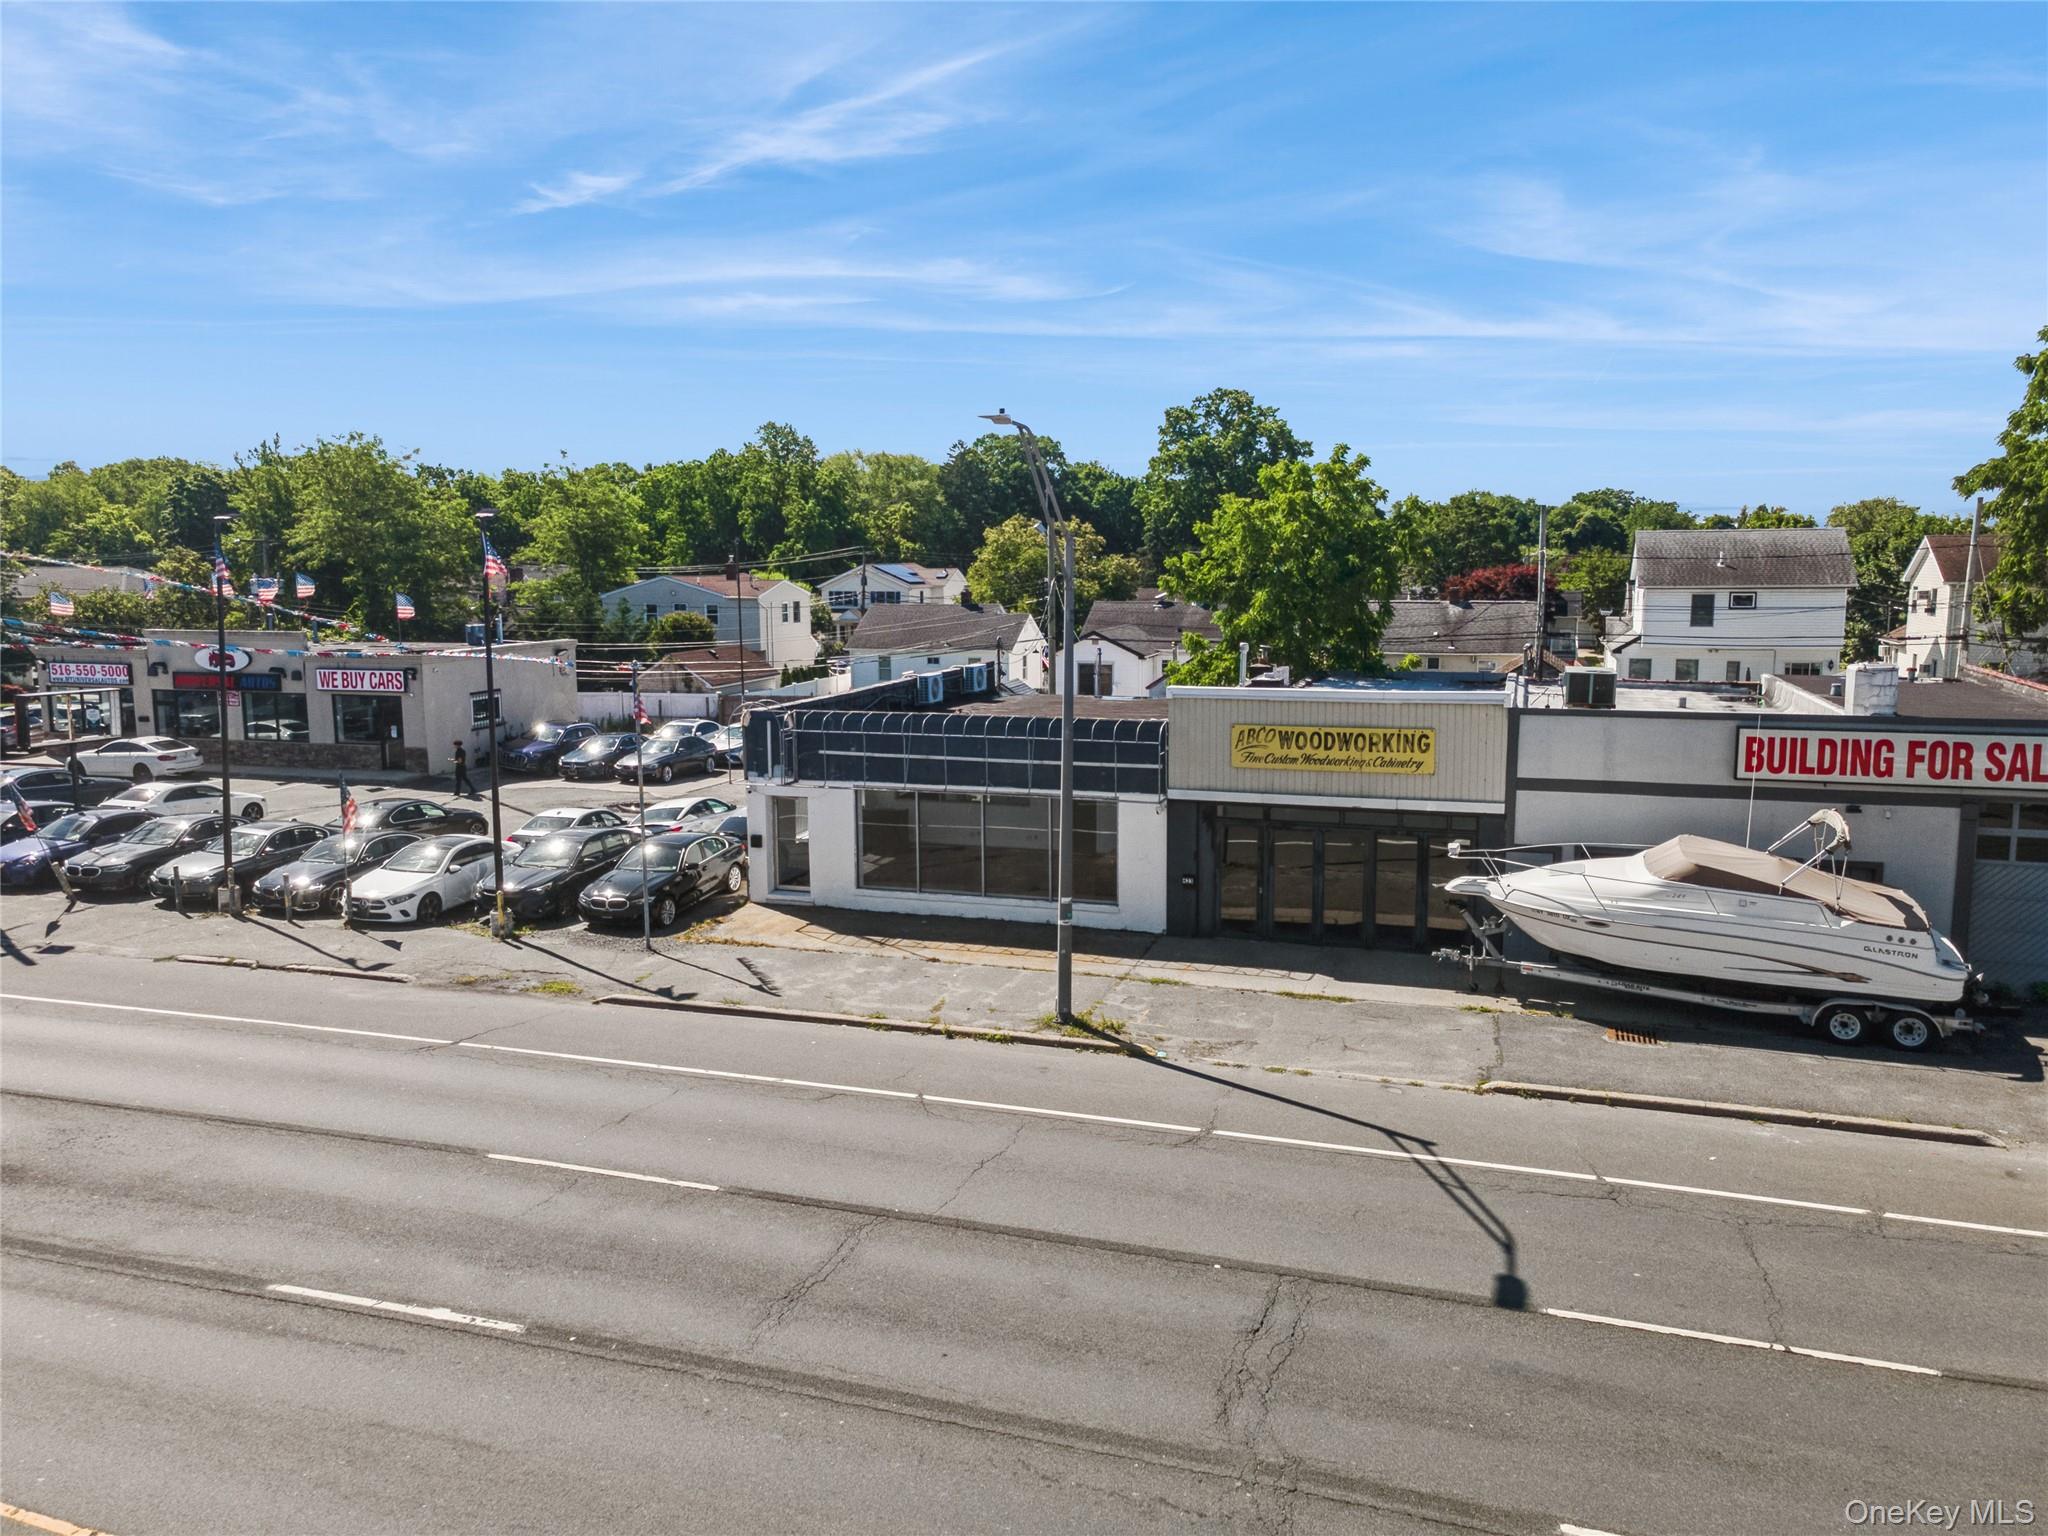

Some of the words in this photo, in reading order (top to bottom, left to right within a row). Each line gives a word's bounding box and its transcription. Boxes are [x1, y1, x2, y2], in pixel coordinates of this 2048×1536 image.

[51, 664, 128, 677] 516-550-5000
[319, 671, 339, 689] WE
[341, 671, 365, 689] BUY
[369, 672, 403, 690] CARS
[1235, 727, 1276, 749] ABCO
[1278, 729, 1431, 754] WOODWORKING
[1240, 751, 1262, 764] Fine
[1264, 752, 1299, 765] Custom
[1300, 753, 1366, 770] Woodworking
[1372, 755, 1424, 773] Cabinetry
[1744, 735, 1895, 778] BUILDING
[1906, 740, 1974, 780] FOR
[1984, 742, 2048, 782] SAL
